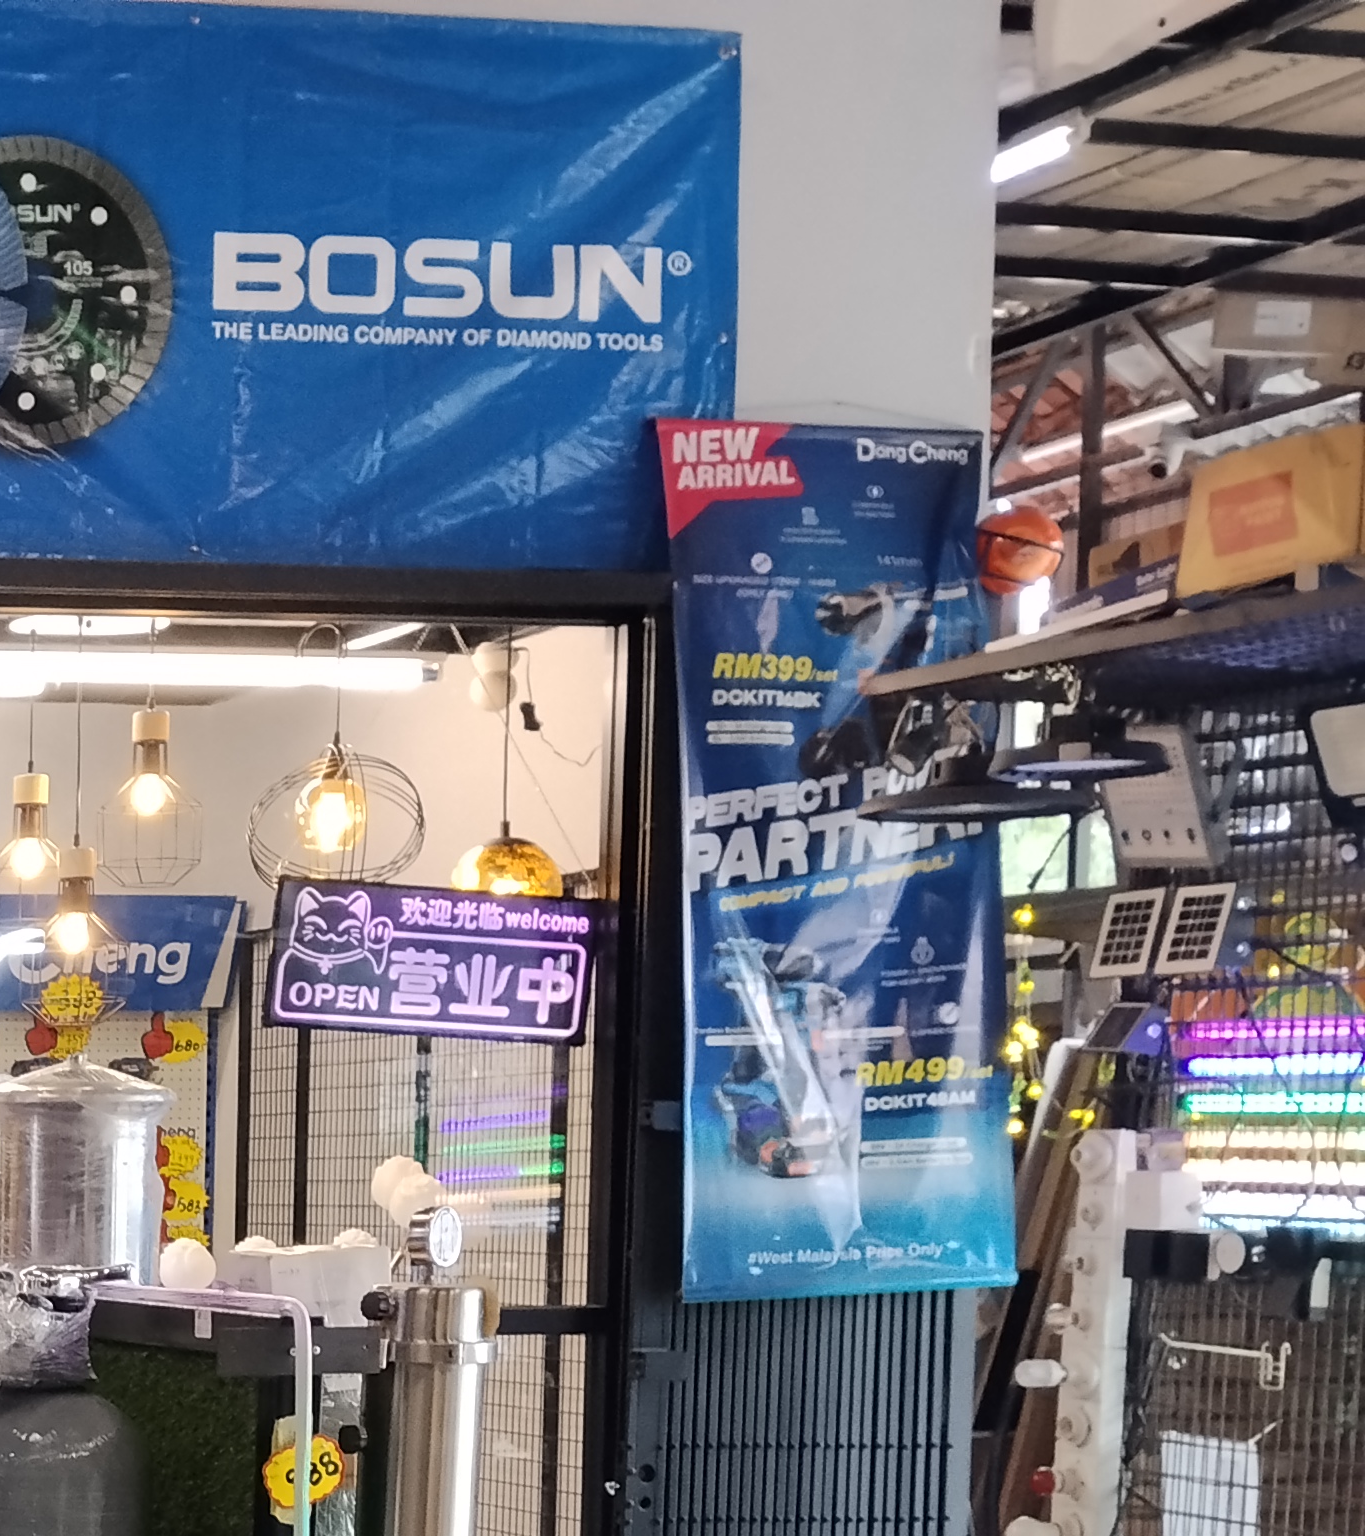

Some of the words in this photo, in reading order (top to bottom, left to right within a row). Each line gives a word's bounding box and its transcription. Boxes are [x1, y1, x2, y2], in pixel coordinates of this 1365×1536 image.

[63, 260, 93, 276] 105
[212, 321, 253, 341] THE
[259, 322, 349, 344] LEADING
[355, 325, 457, 347] COMPANY
[463, 327, 491, 347] OF
[497, 330, 592, 350] DIAMOND
[597, 332, 664, 353] TOOLS
[672, 426, 760, 464] NEW
[677, 459, 796, 491] ARRIVAL
[688, 773, 849, 830] PERFECT
[399, 896, 503, 932] 欢迎光临
[504, 907, 590, 934] welcome
[289, 981, 379, 1012] OPEN
[388, 946, 574, 1025] 营业中
[907, 1241, 944, 1259] Only
